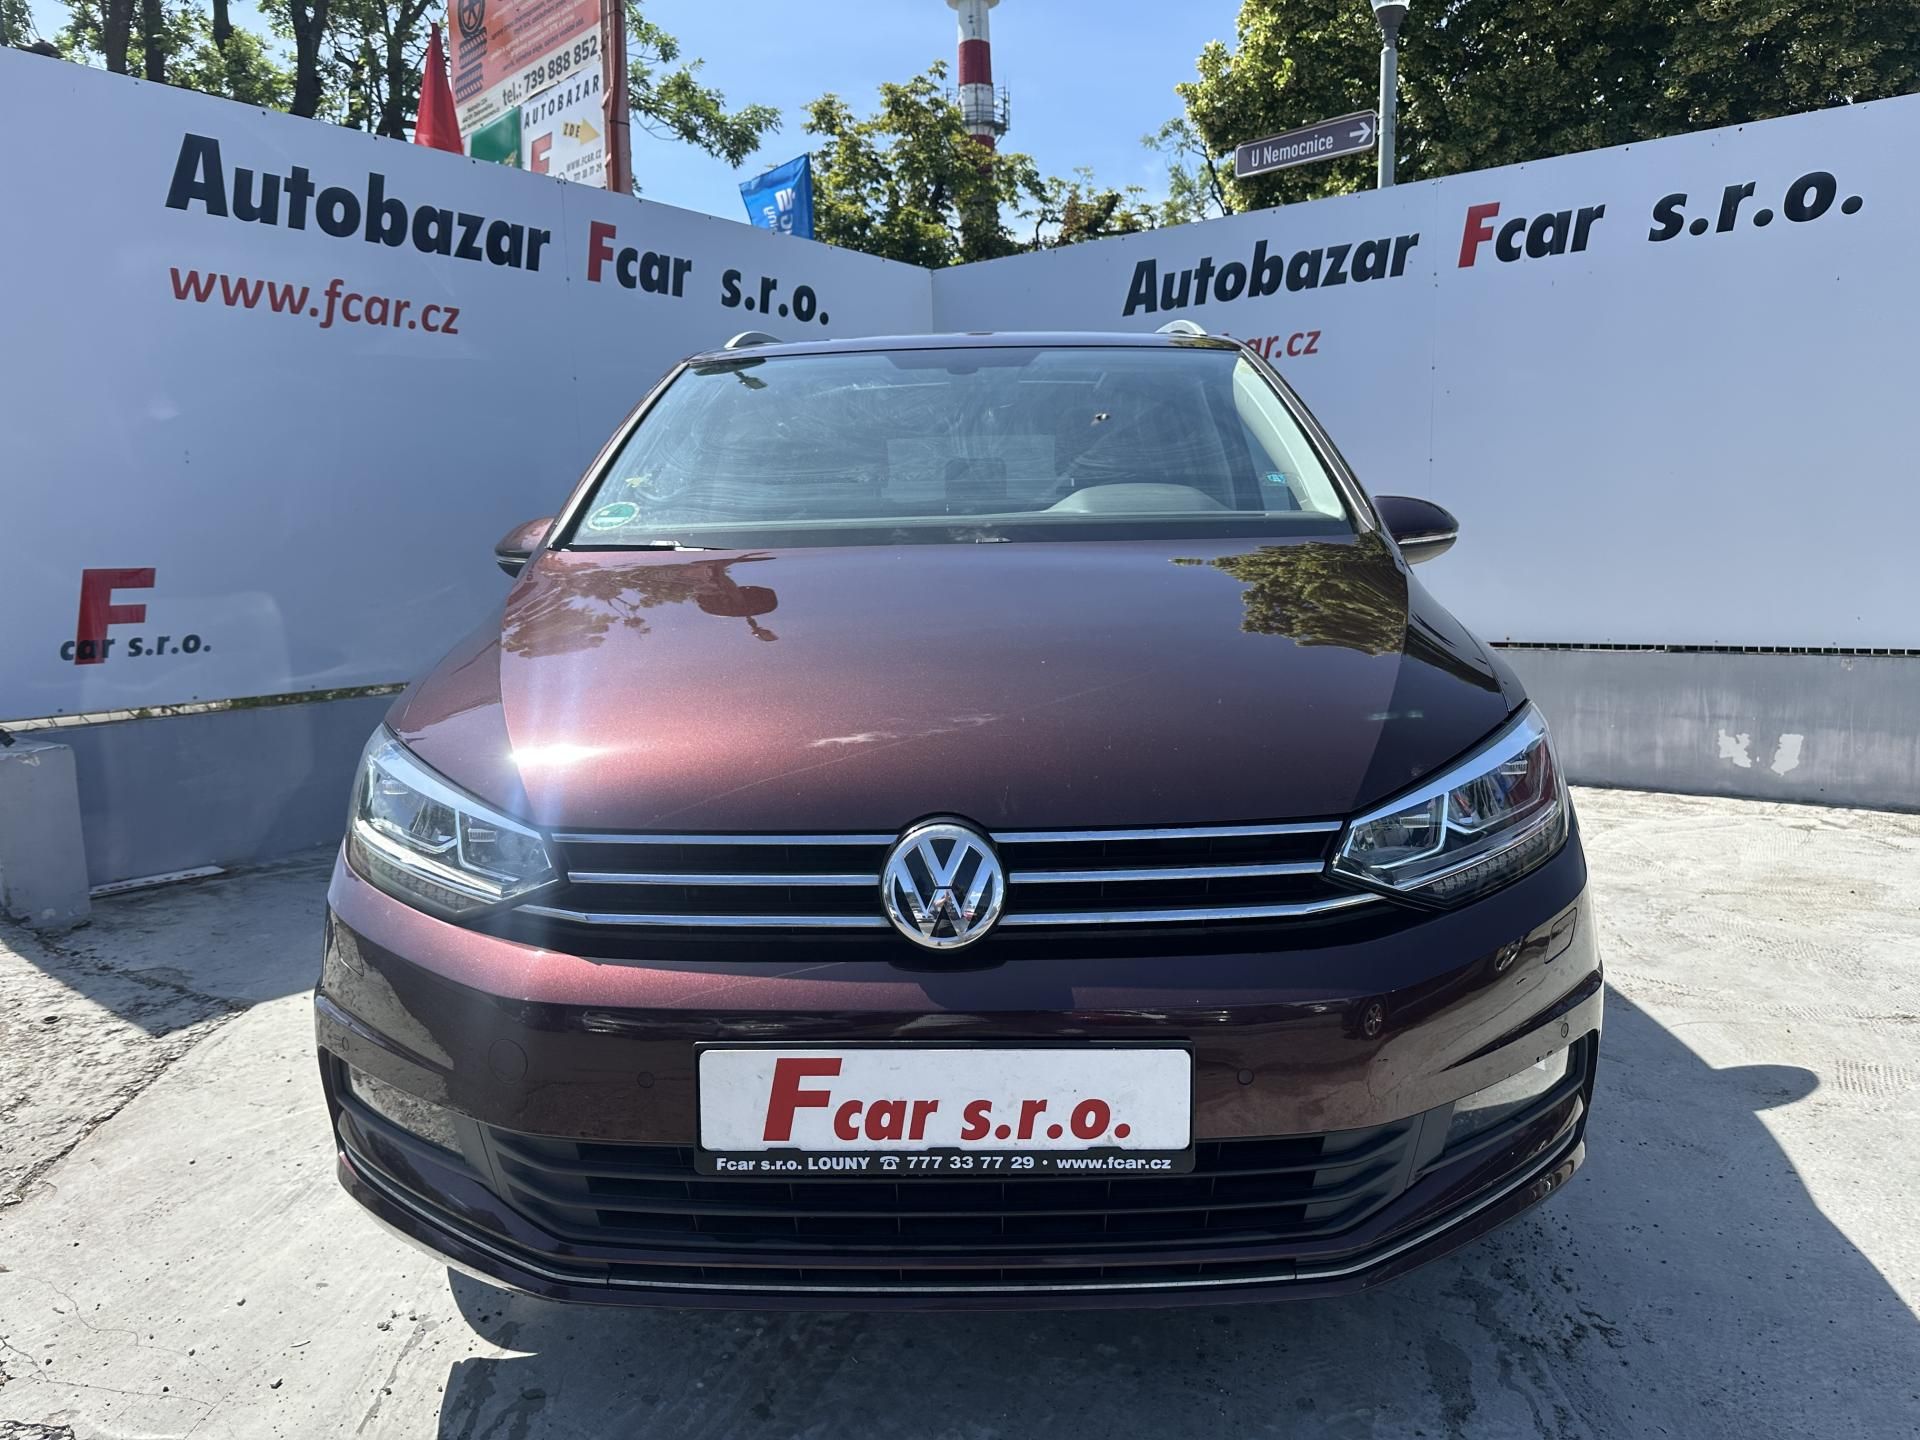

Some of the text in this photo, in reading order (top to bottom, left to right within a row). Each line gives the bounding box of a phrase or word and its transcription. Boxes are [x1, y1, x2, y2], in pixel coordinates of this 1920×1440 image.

[503, 35, 597, 106] tel.: 739 888 852
[524, 74, 599, 130] AUTOBAZAR
[563, 122, 580, 138] ZDE
[1251, 135, 1333, 167] U Nemocnice
[166, 133, 829, 325] Autobazar Fcar s.r.o.
[1122, 171, 1863, 317] Autobazar Fcar s.r.o.
[170, 267, 460, 335] www.fcar.cz
[128, 634, 212, 657] s.r.o.
[763, 1058, 1131, 1141] Fcar s.r.o.
[716, 1156, 1172, 1170] Fcar s.r.o. LOUNY 777 33 77 29 www.fcar.cz
